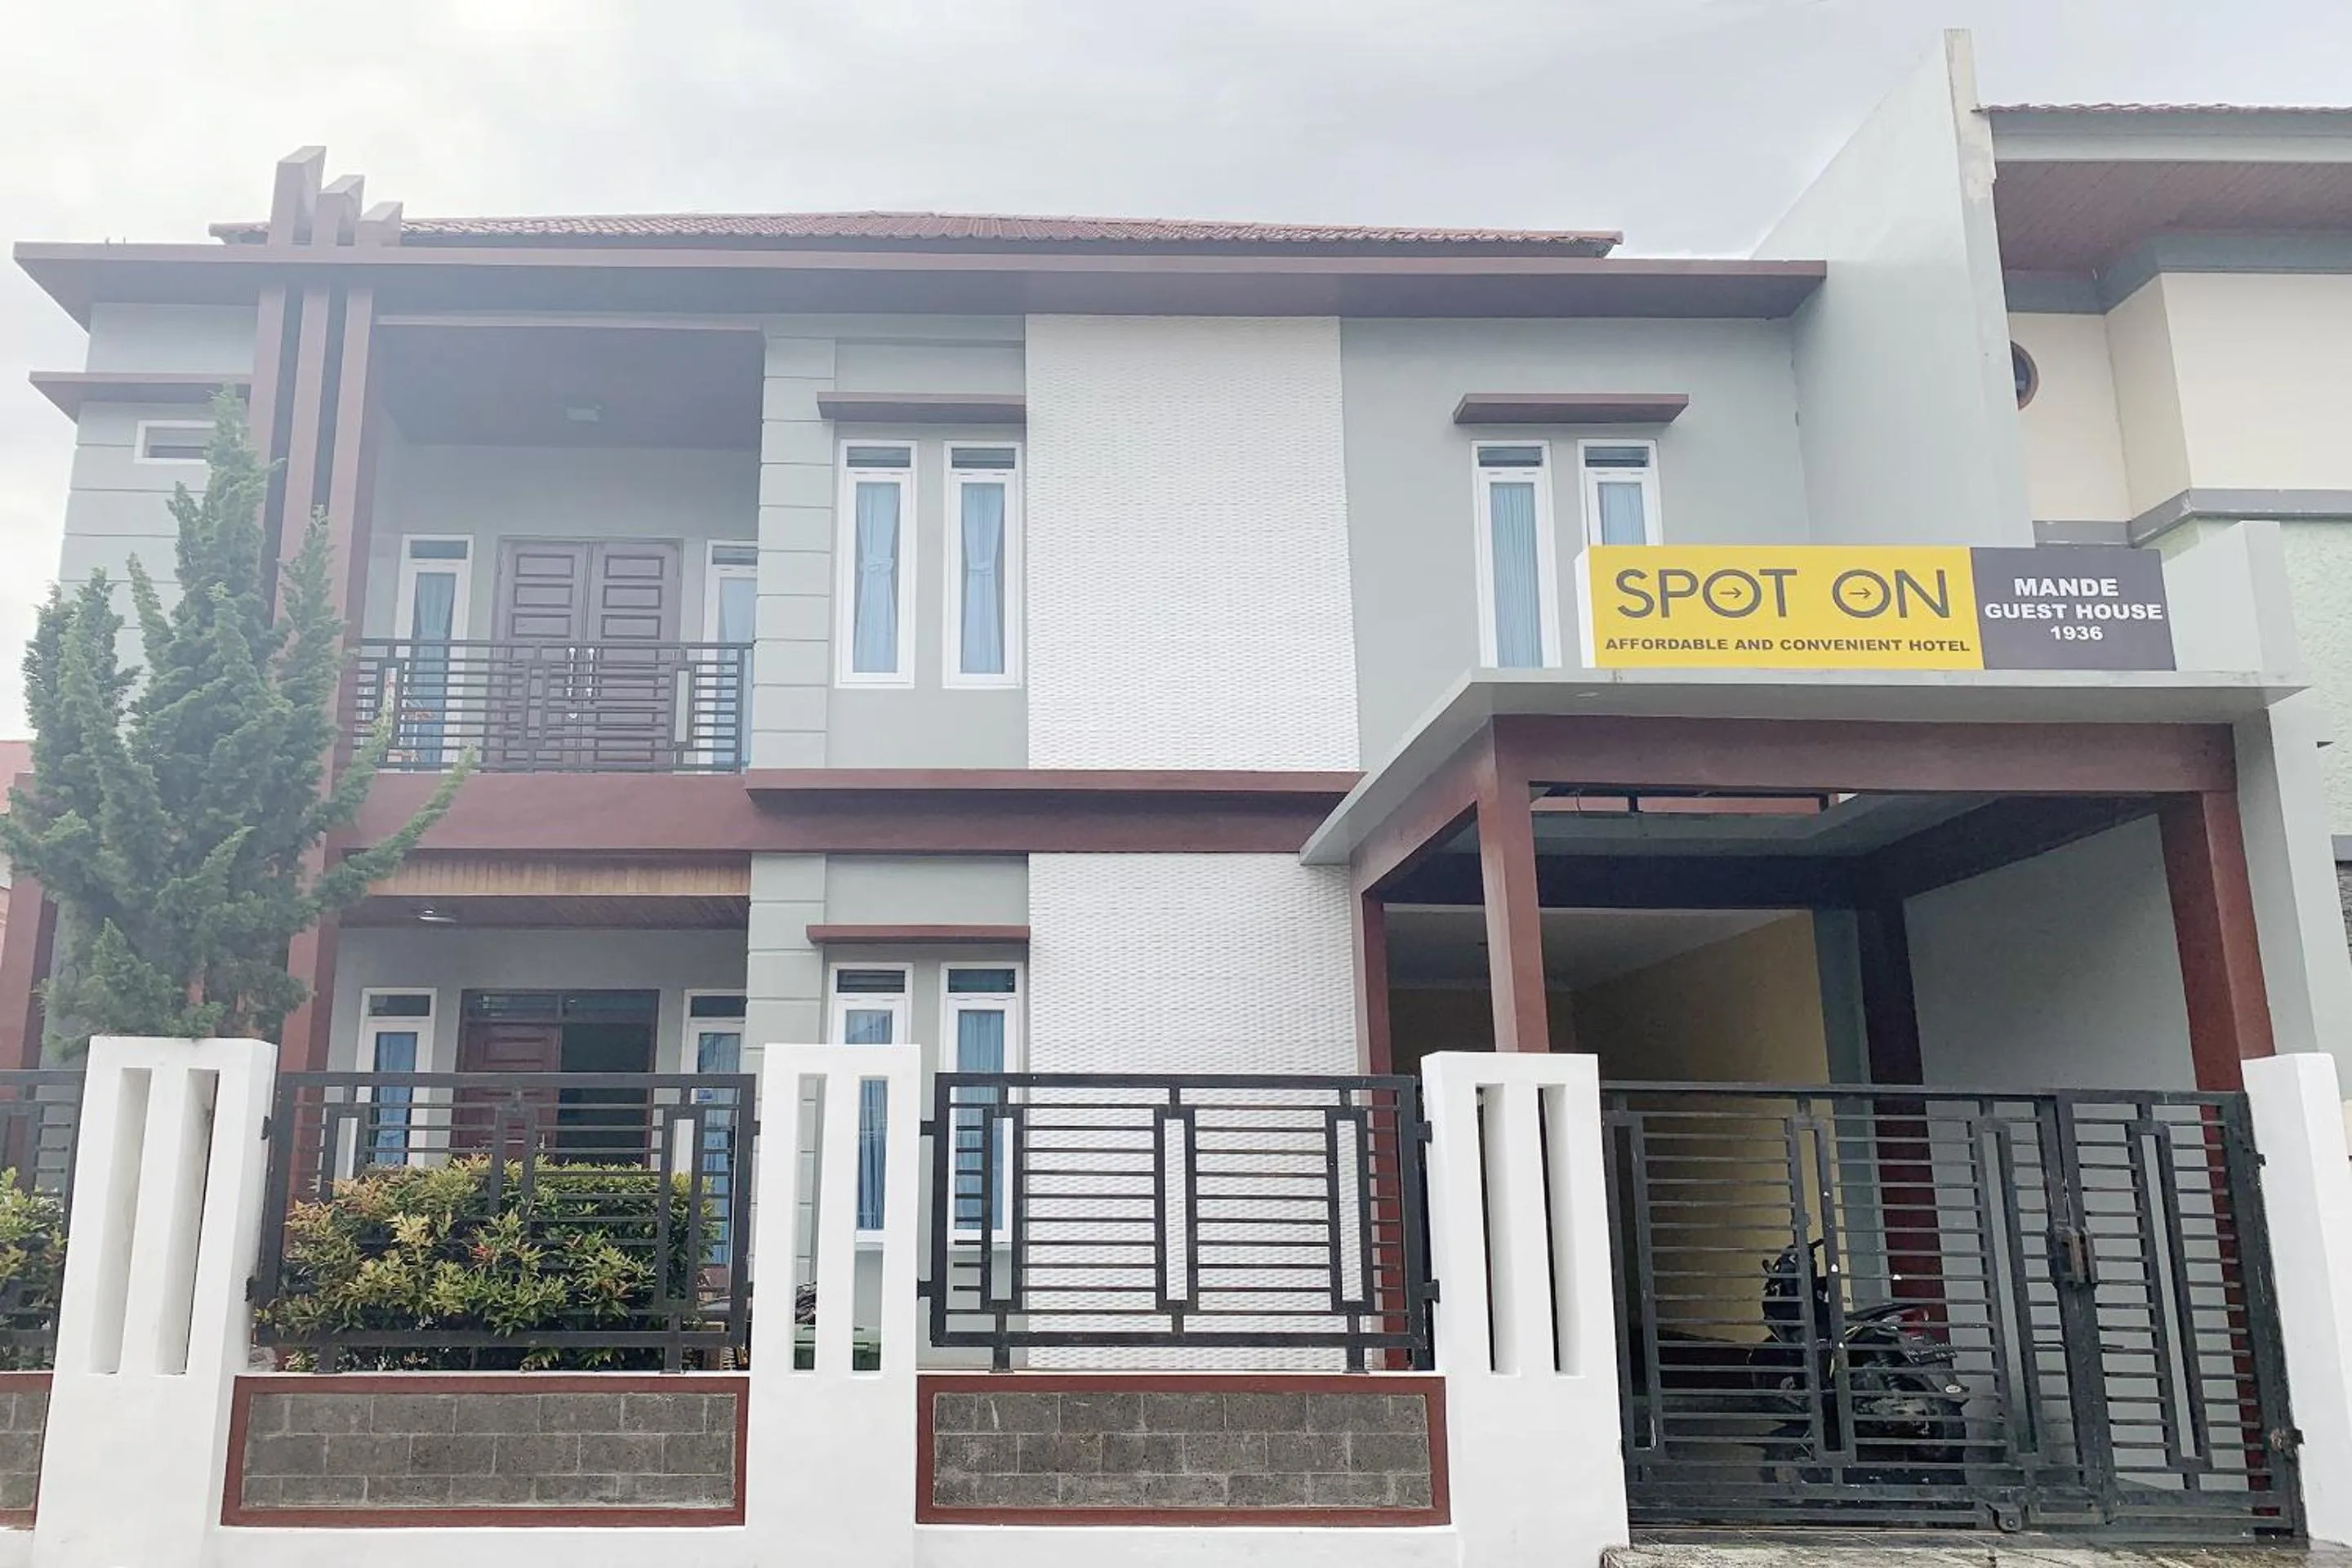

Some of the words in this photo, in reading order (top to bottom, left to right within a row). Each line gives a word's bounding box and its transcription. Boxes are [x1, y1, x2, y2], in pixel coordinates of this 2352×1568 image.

[1615, 569, 1797, 618] SPOT
[1833, 569, 1949, 618] ON
[2015, 577, 2118, 597] MANDE
[1984, 603, 2067, 620] GUEST
[2076, 604, 2163, 621] HOUSE
[2050, 626, 2104, 640] 1936
[1606, 639, 1728, 651] AFFORDABLE
[1735, 639, 1774, 651] AND
[1780, 639, 1903, 652] CONVENIENT
[1909, 639, 1970, 652] HOTEL
